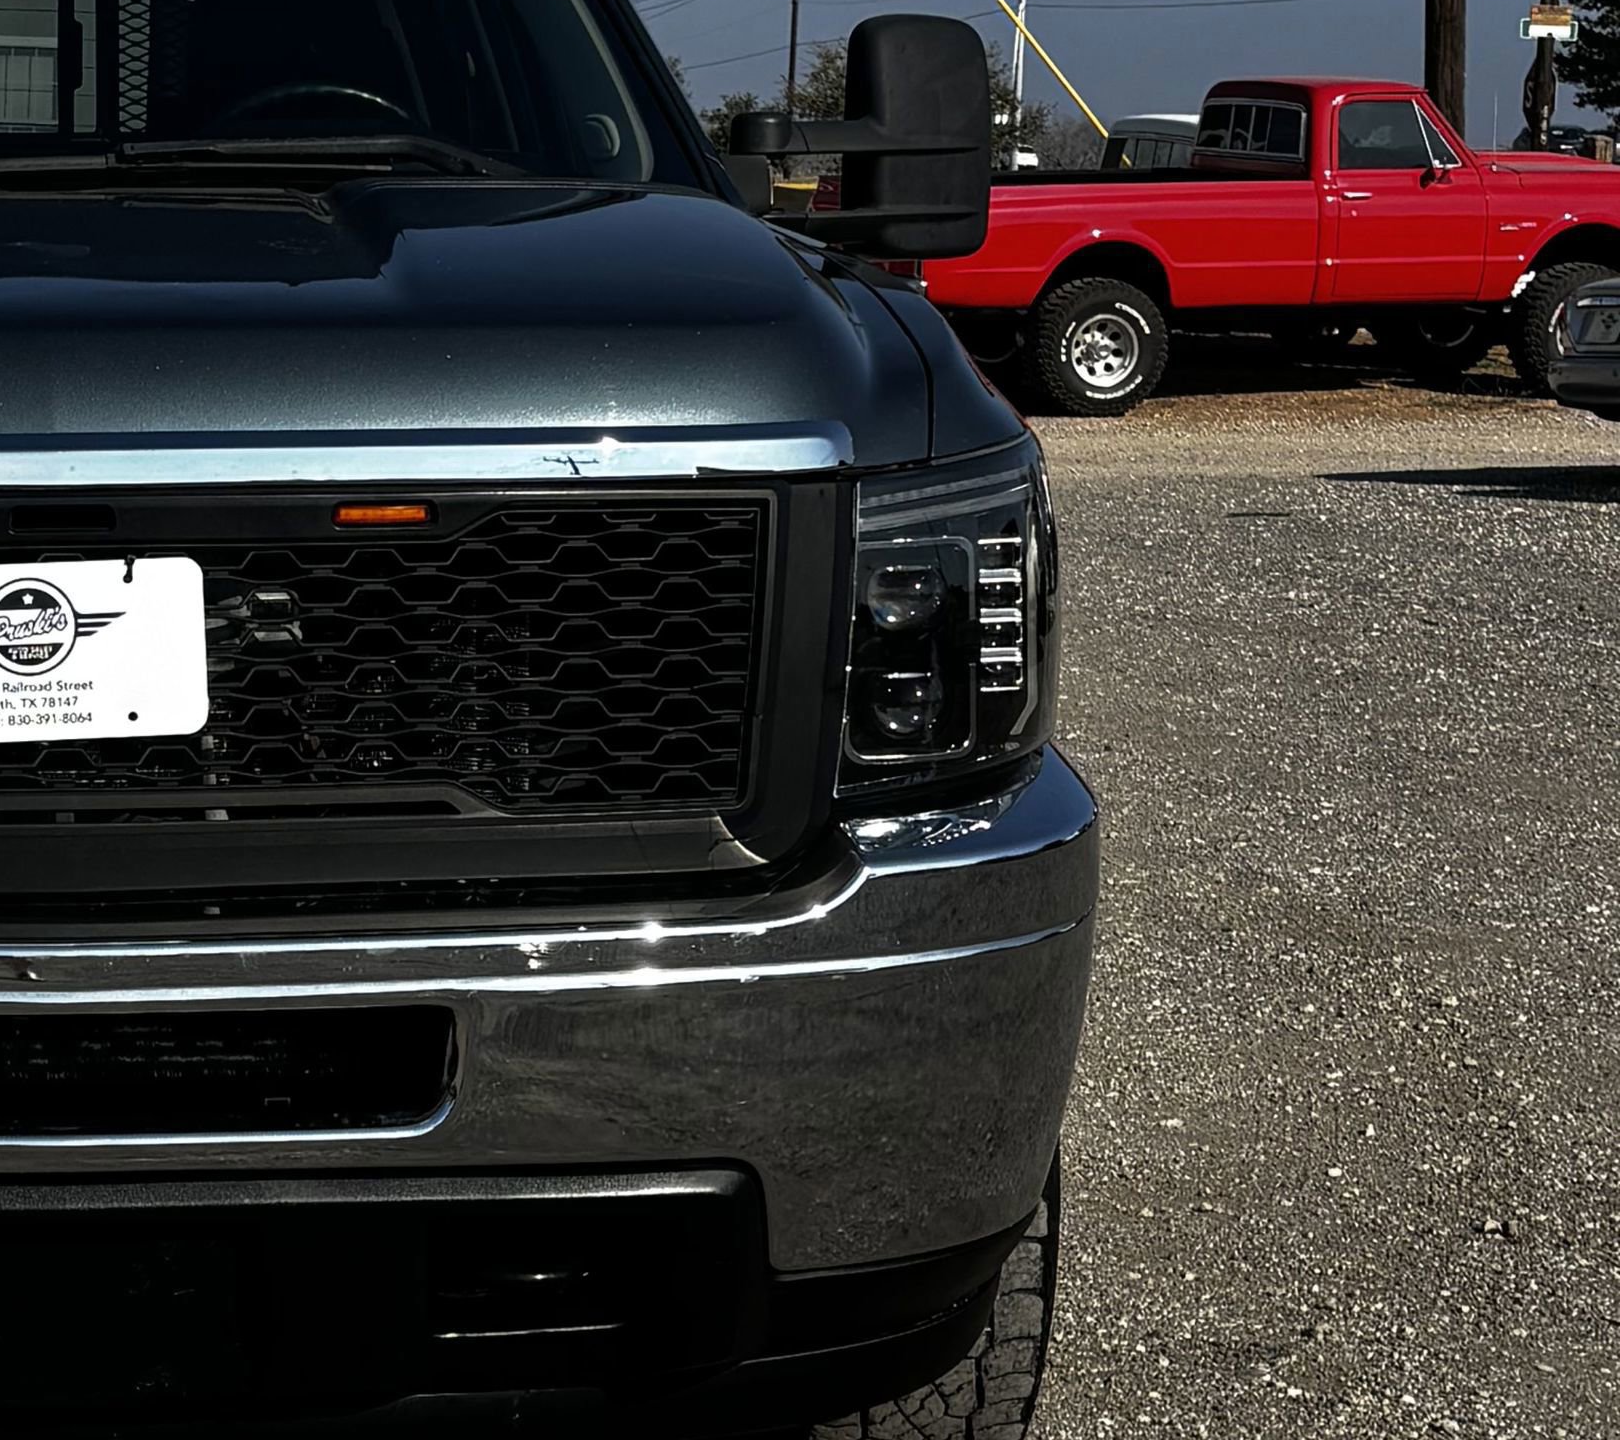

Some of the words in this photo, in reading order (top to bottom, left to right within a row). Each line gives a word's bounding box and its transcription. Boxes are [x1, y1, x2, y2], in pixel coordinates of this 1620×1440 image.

[2, 681, 52, 693] Railroad
[56, 680, 93, 691] Street
[20, 698, 37, 708] TX
[41, 696, 78, 708] 78147
[8, 712, 92, 726] 830-391-8064
